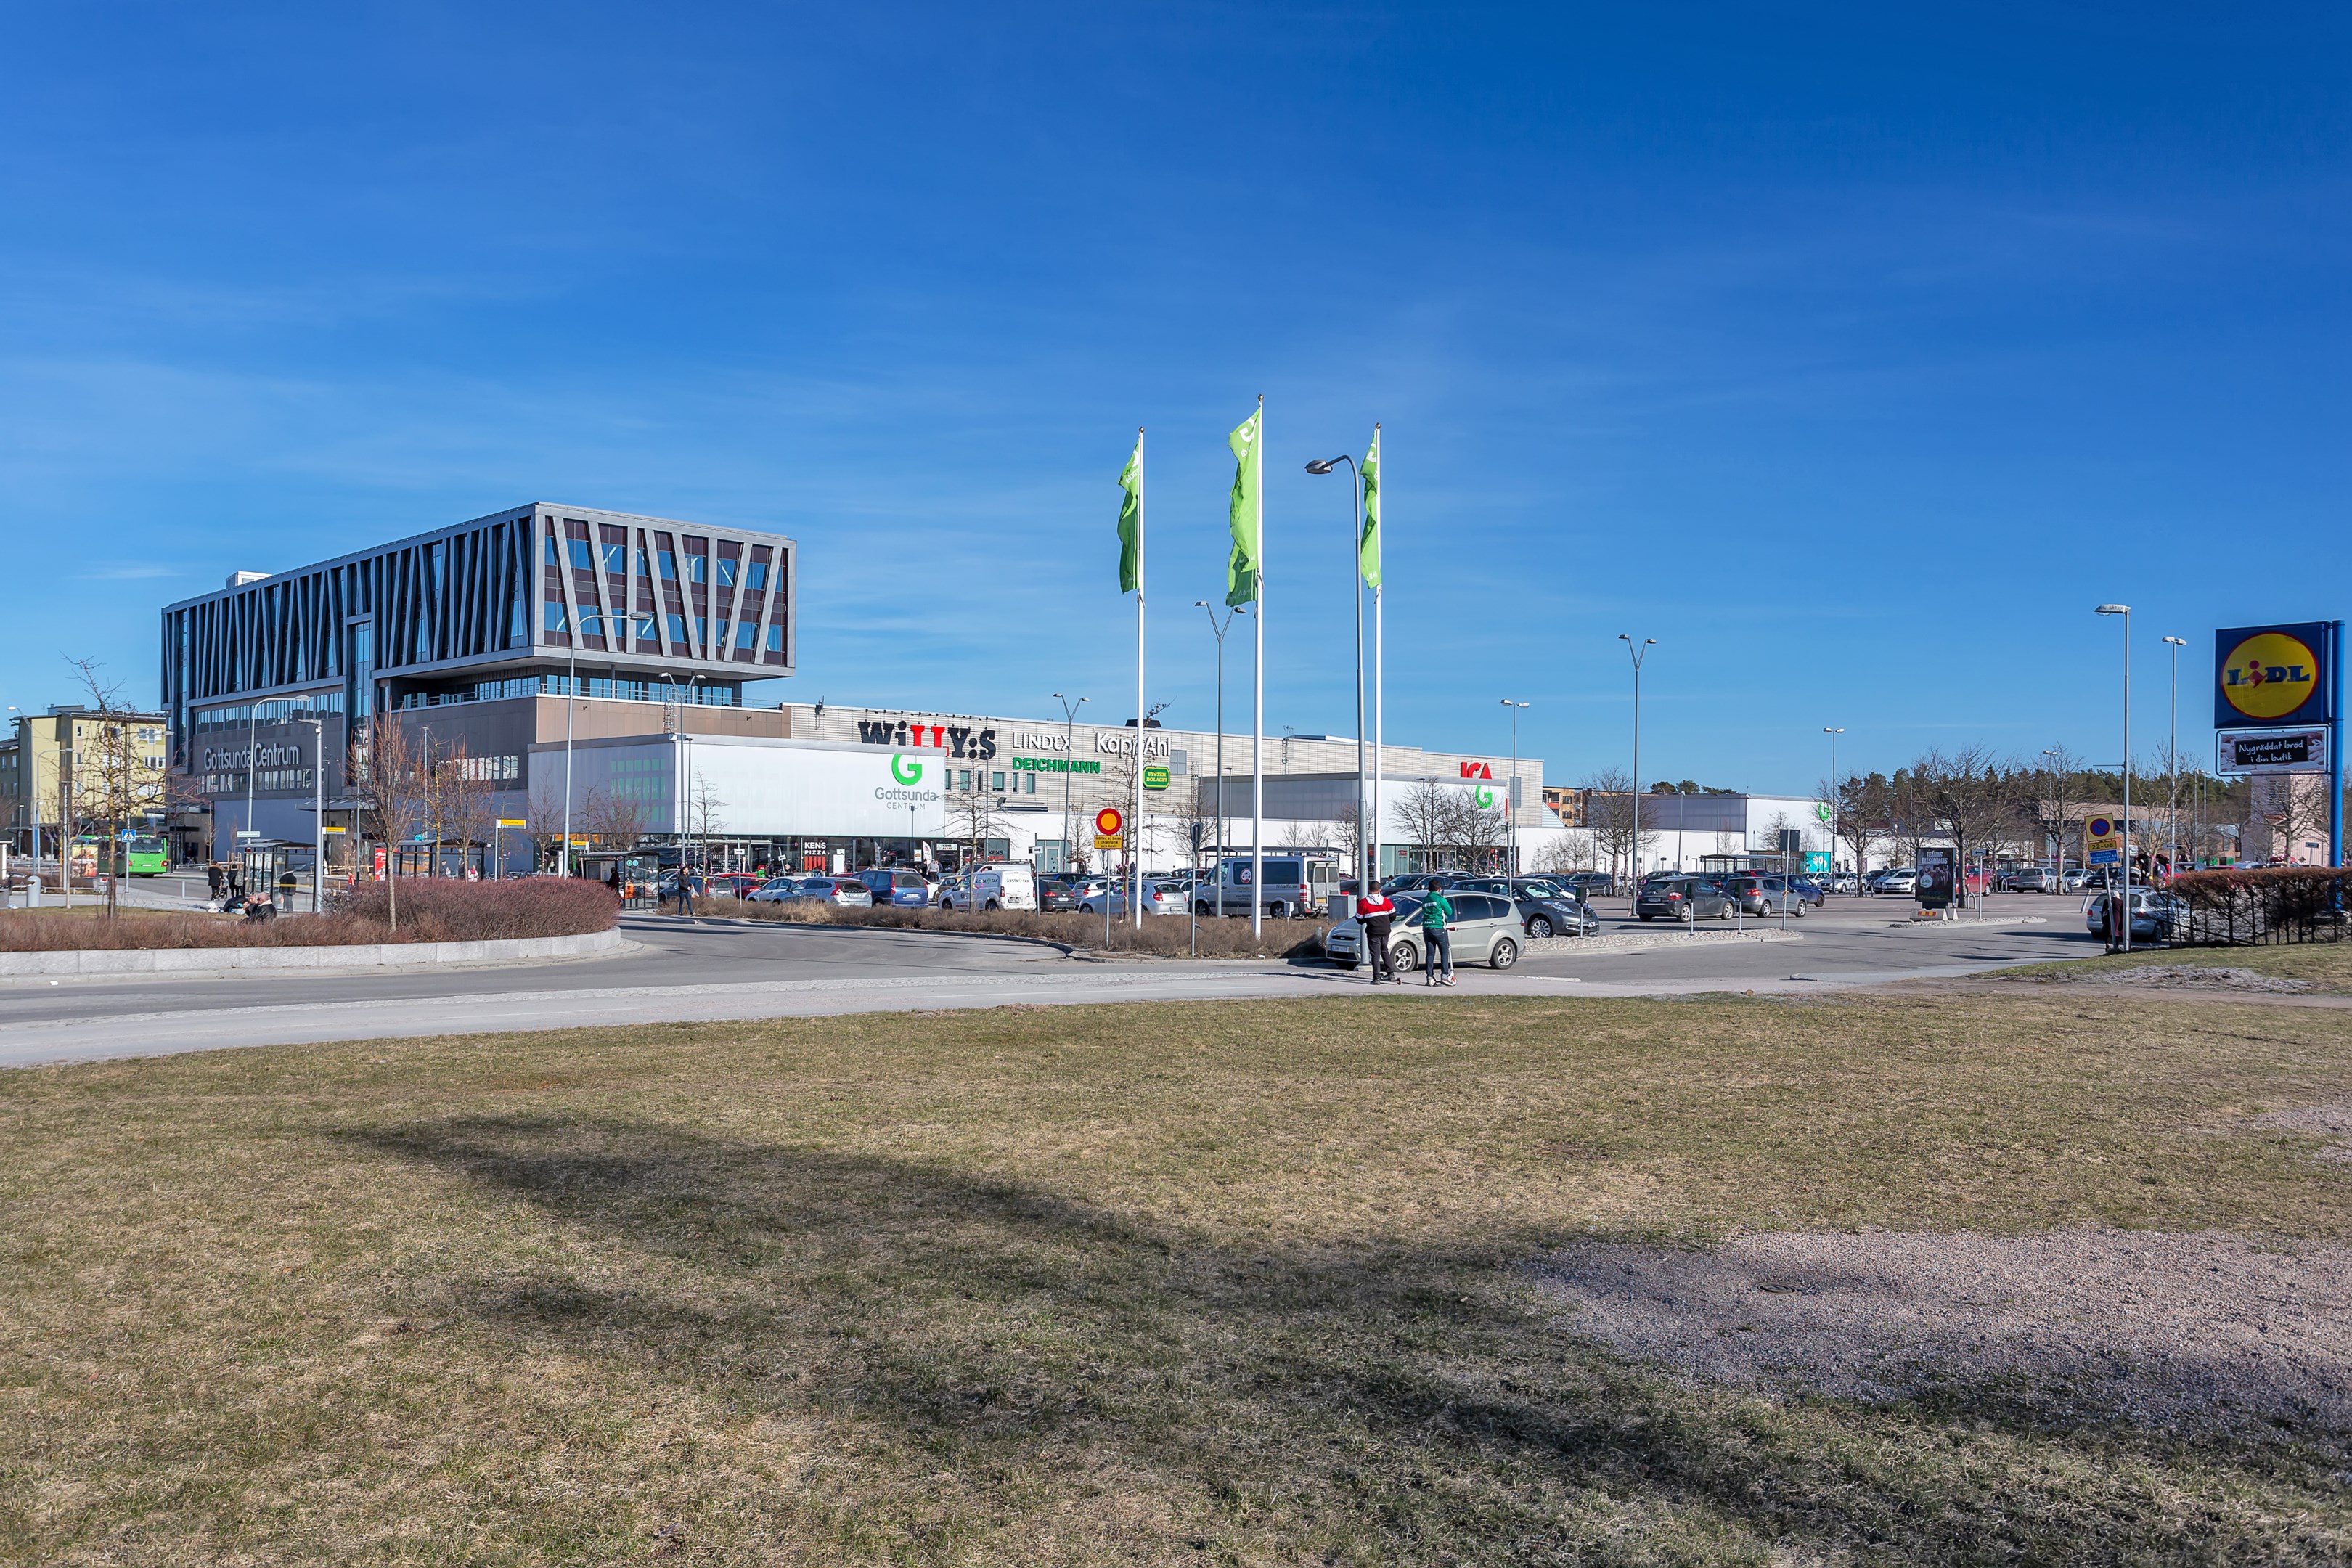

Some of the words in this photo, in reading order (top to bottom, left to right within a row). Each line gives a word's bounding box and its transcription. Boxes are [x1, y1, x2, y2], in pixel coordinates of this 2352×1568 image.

[1013, 732, 1073, 751] LINDEX
[2239, 741, 2282, 755] Nygräddat
[2284, 739, 2303, 750] bröd
[204, 746, 251, 771] Gottsunda
[254, 743, 299, 767] Centrum
[1013, 756, 1100, 773] DEICHMANN
[2271, 753, 2292, 761] butik
[875, 787, 936, 801] Gottsunda
[886, 801, 926, 810] CENTRUM
